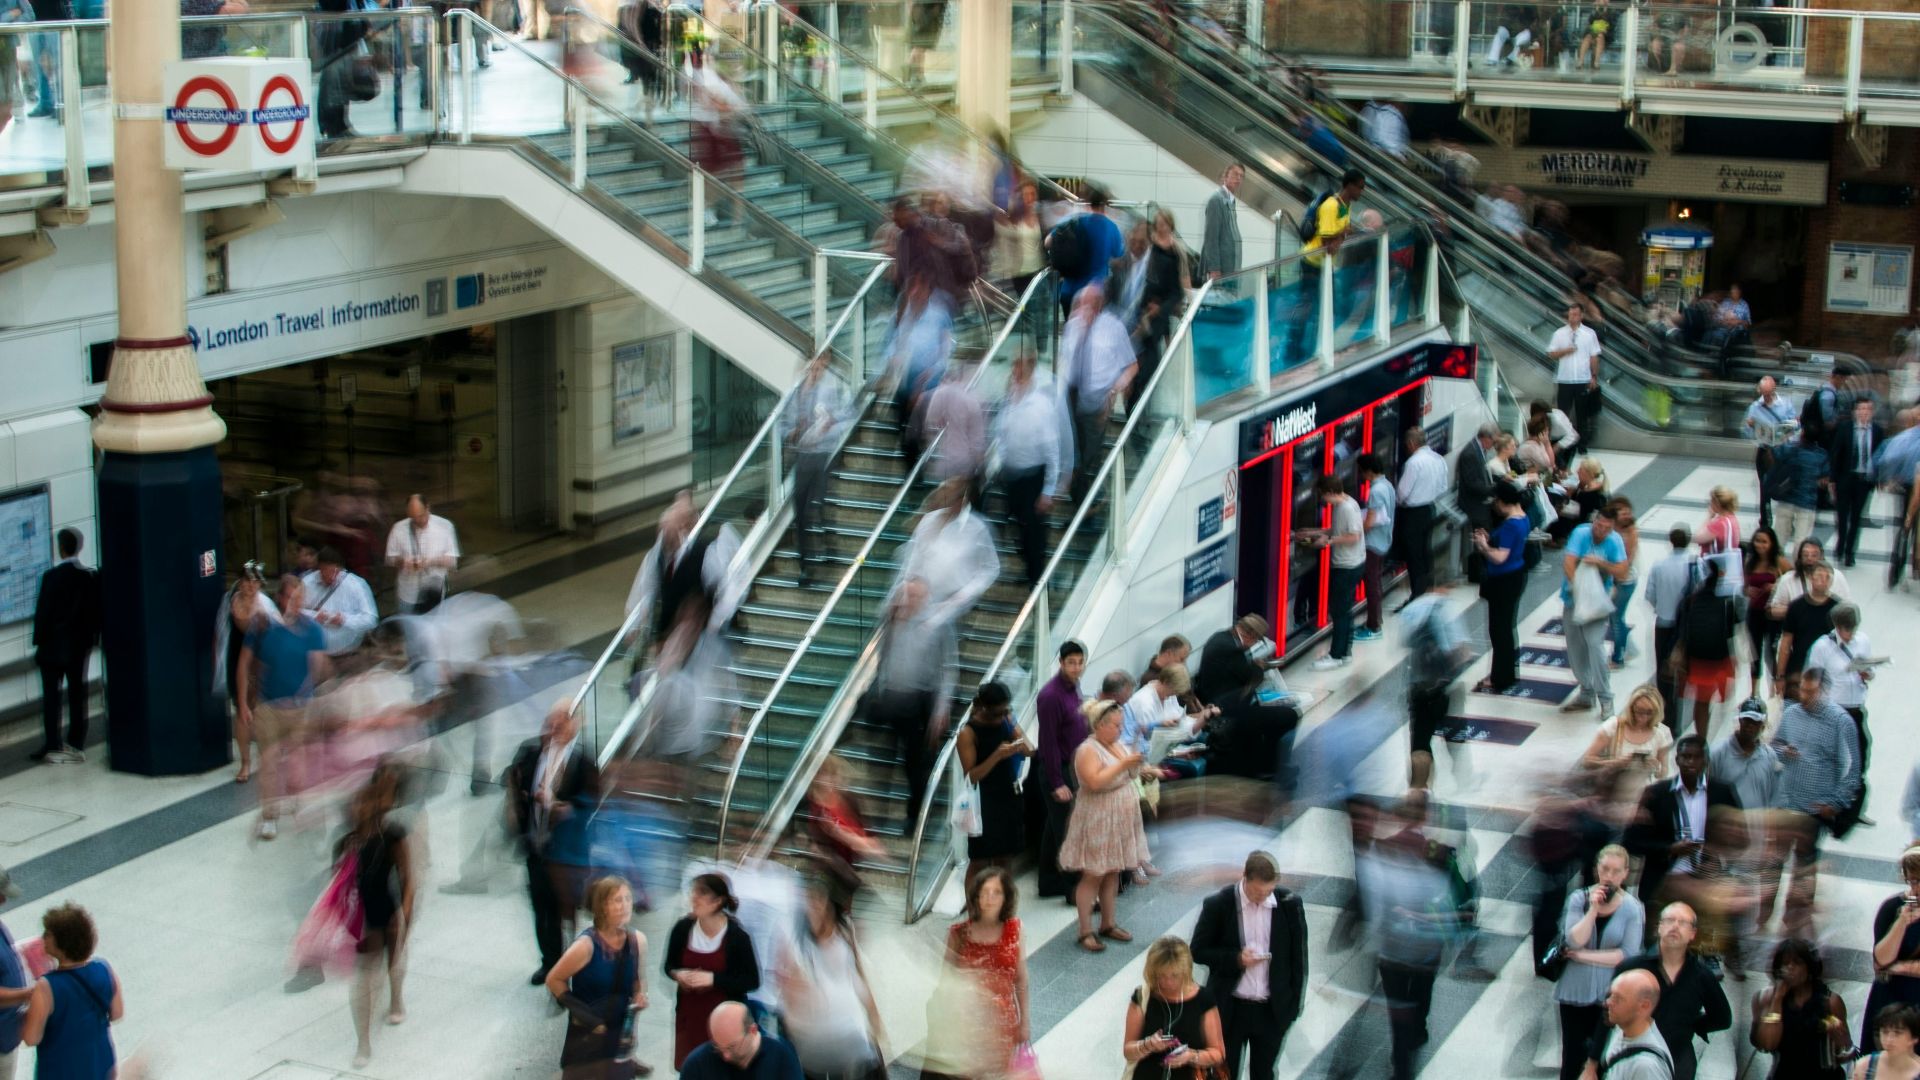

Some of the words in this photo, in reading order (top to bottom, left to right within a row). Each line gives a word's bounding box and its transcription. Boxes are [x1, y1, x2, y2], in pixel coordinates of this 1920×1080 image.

[170, 109, 243, 121] UNDERGROUND
[255, 107, 308, 121] UNDERGROUND
[1541, 152, 1650, 176] MERCHANT
[1717, 164, 1786, 180] Freehouse
[1555, 173, 1635, 188] BISHOPSGATE
[206, 319, 269, 350] London
[276, 307, 325, 335] Travel
[332, 292, 420, 327] Information
[1275, 400, 1317, 446] NatWest
